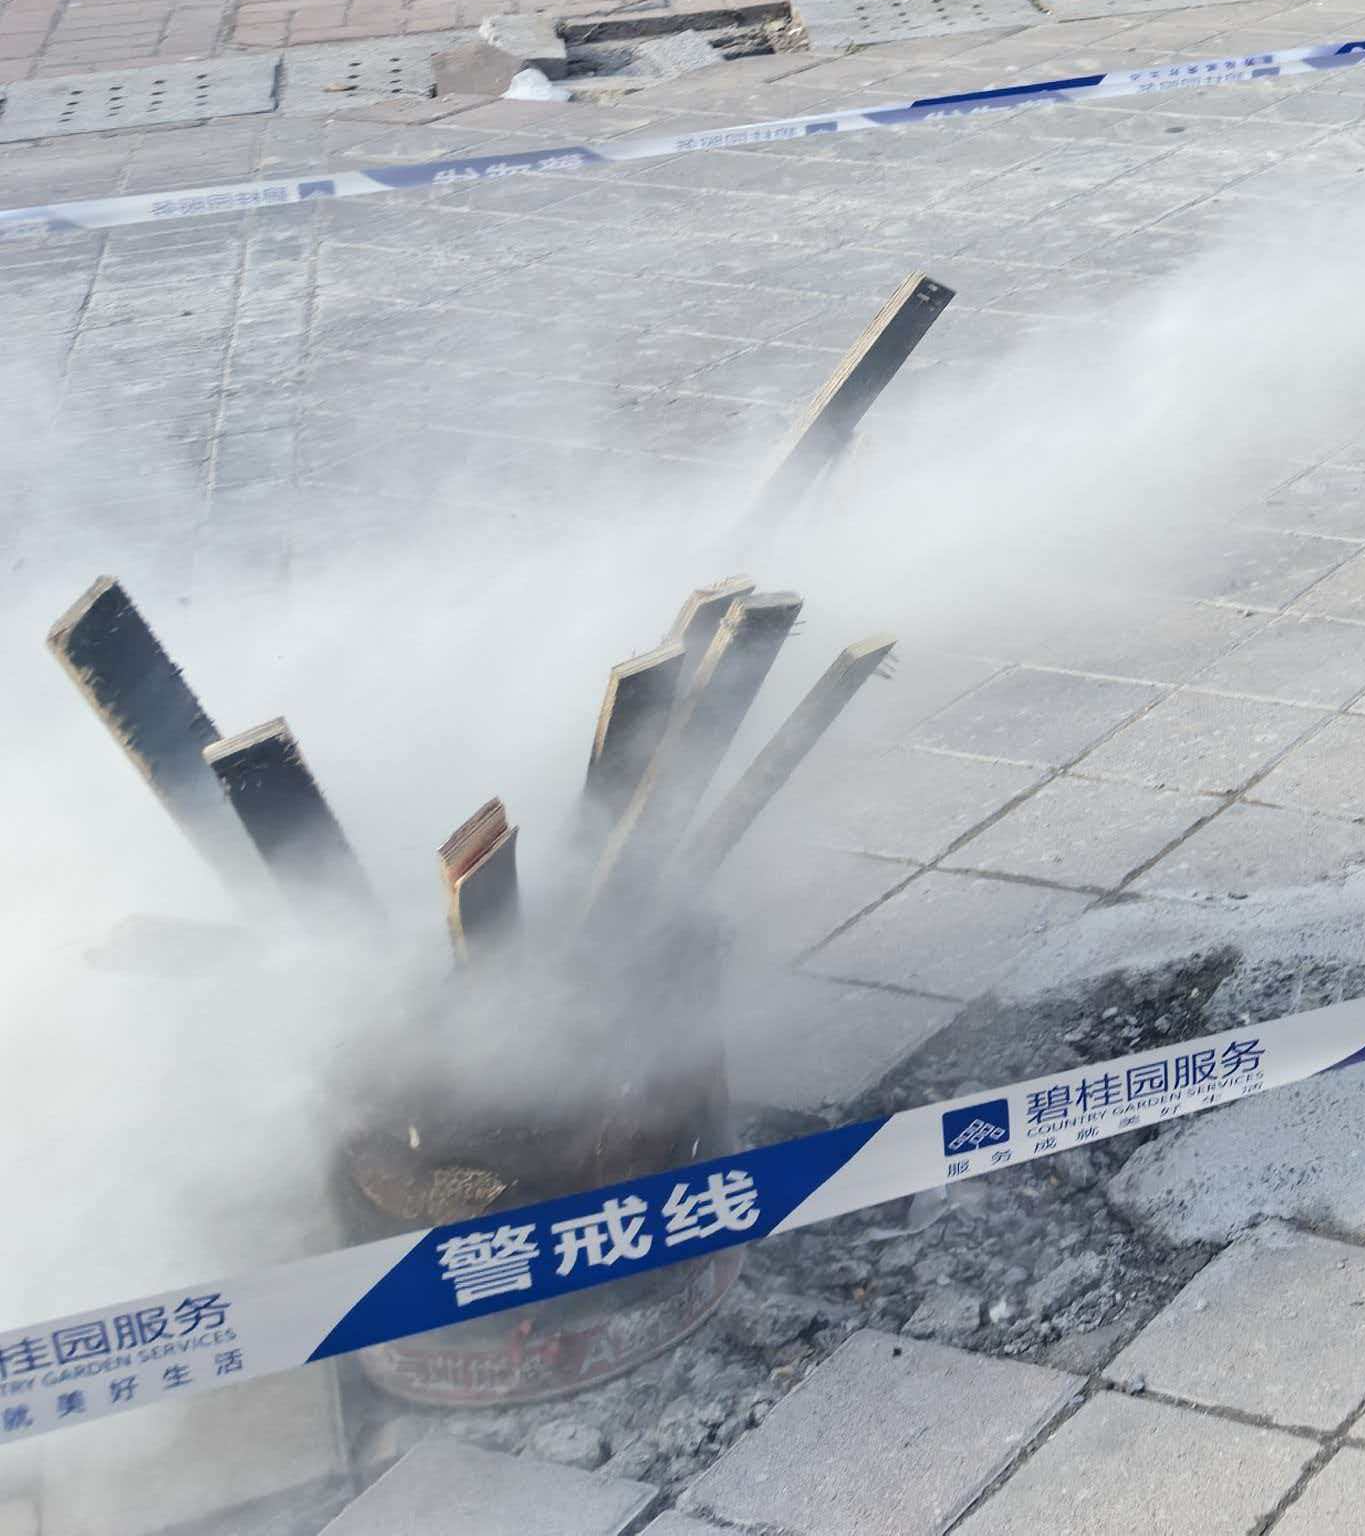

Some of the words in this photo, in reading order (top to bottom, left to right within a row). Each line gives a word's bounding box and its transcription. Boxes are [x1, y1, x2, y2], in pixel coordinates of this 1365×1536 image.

[1026, 1038, 1266, 1125] 碧桂园服务
[1026, 1108, 1107, 1138] COUNTRY
[436, 1169, 761, 1308] 警戒线
[0, 1292, 232, 1379] 桂园服务
[42, 1353, 132, 1385] GARDEN
[138, 1327, 238, 1364] SERVICES
